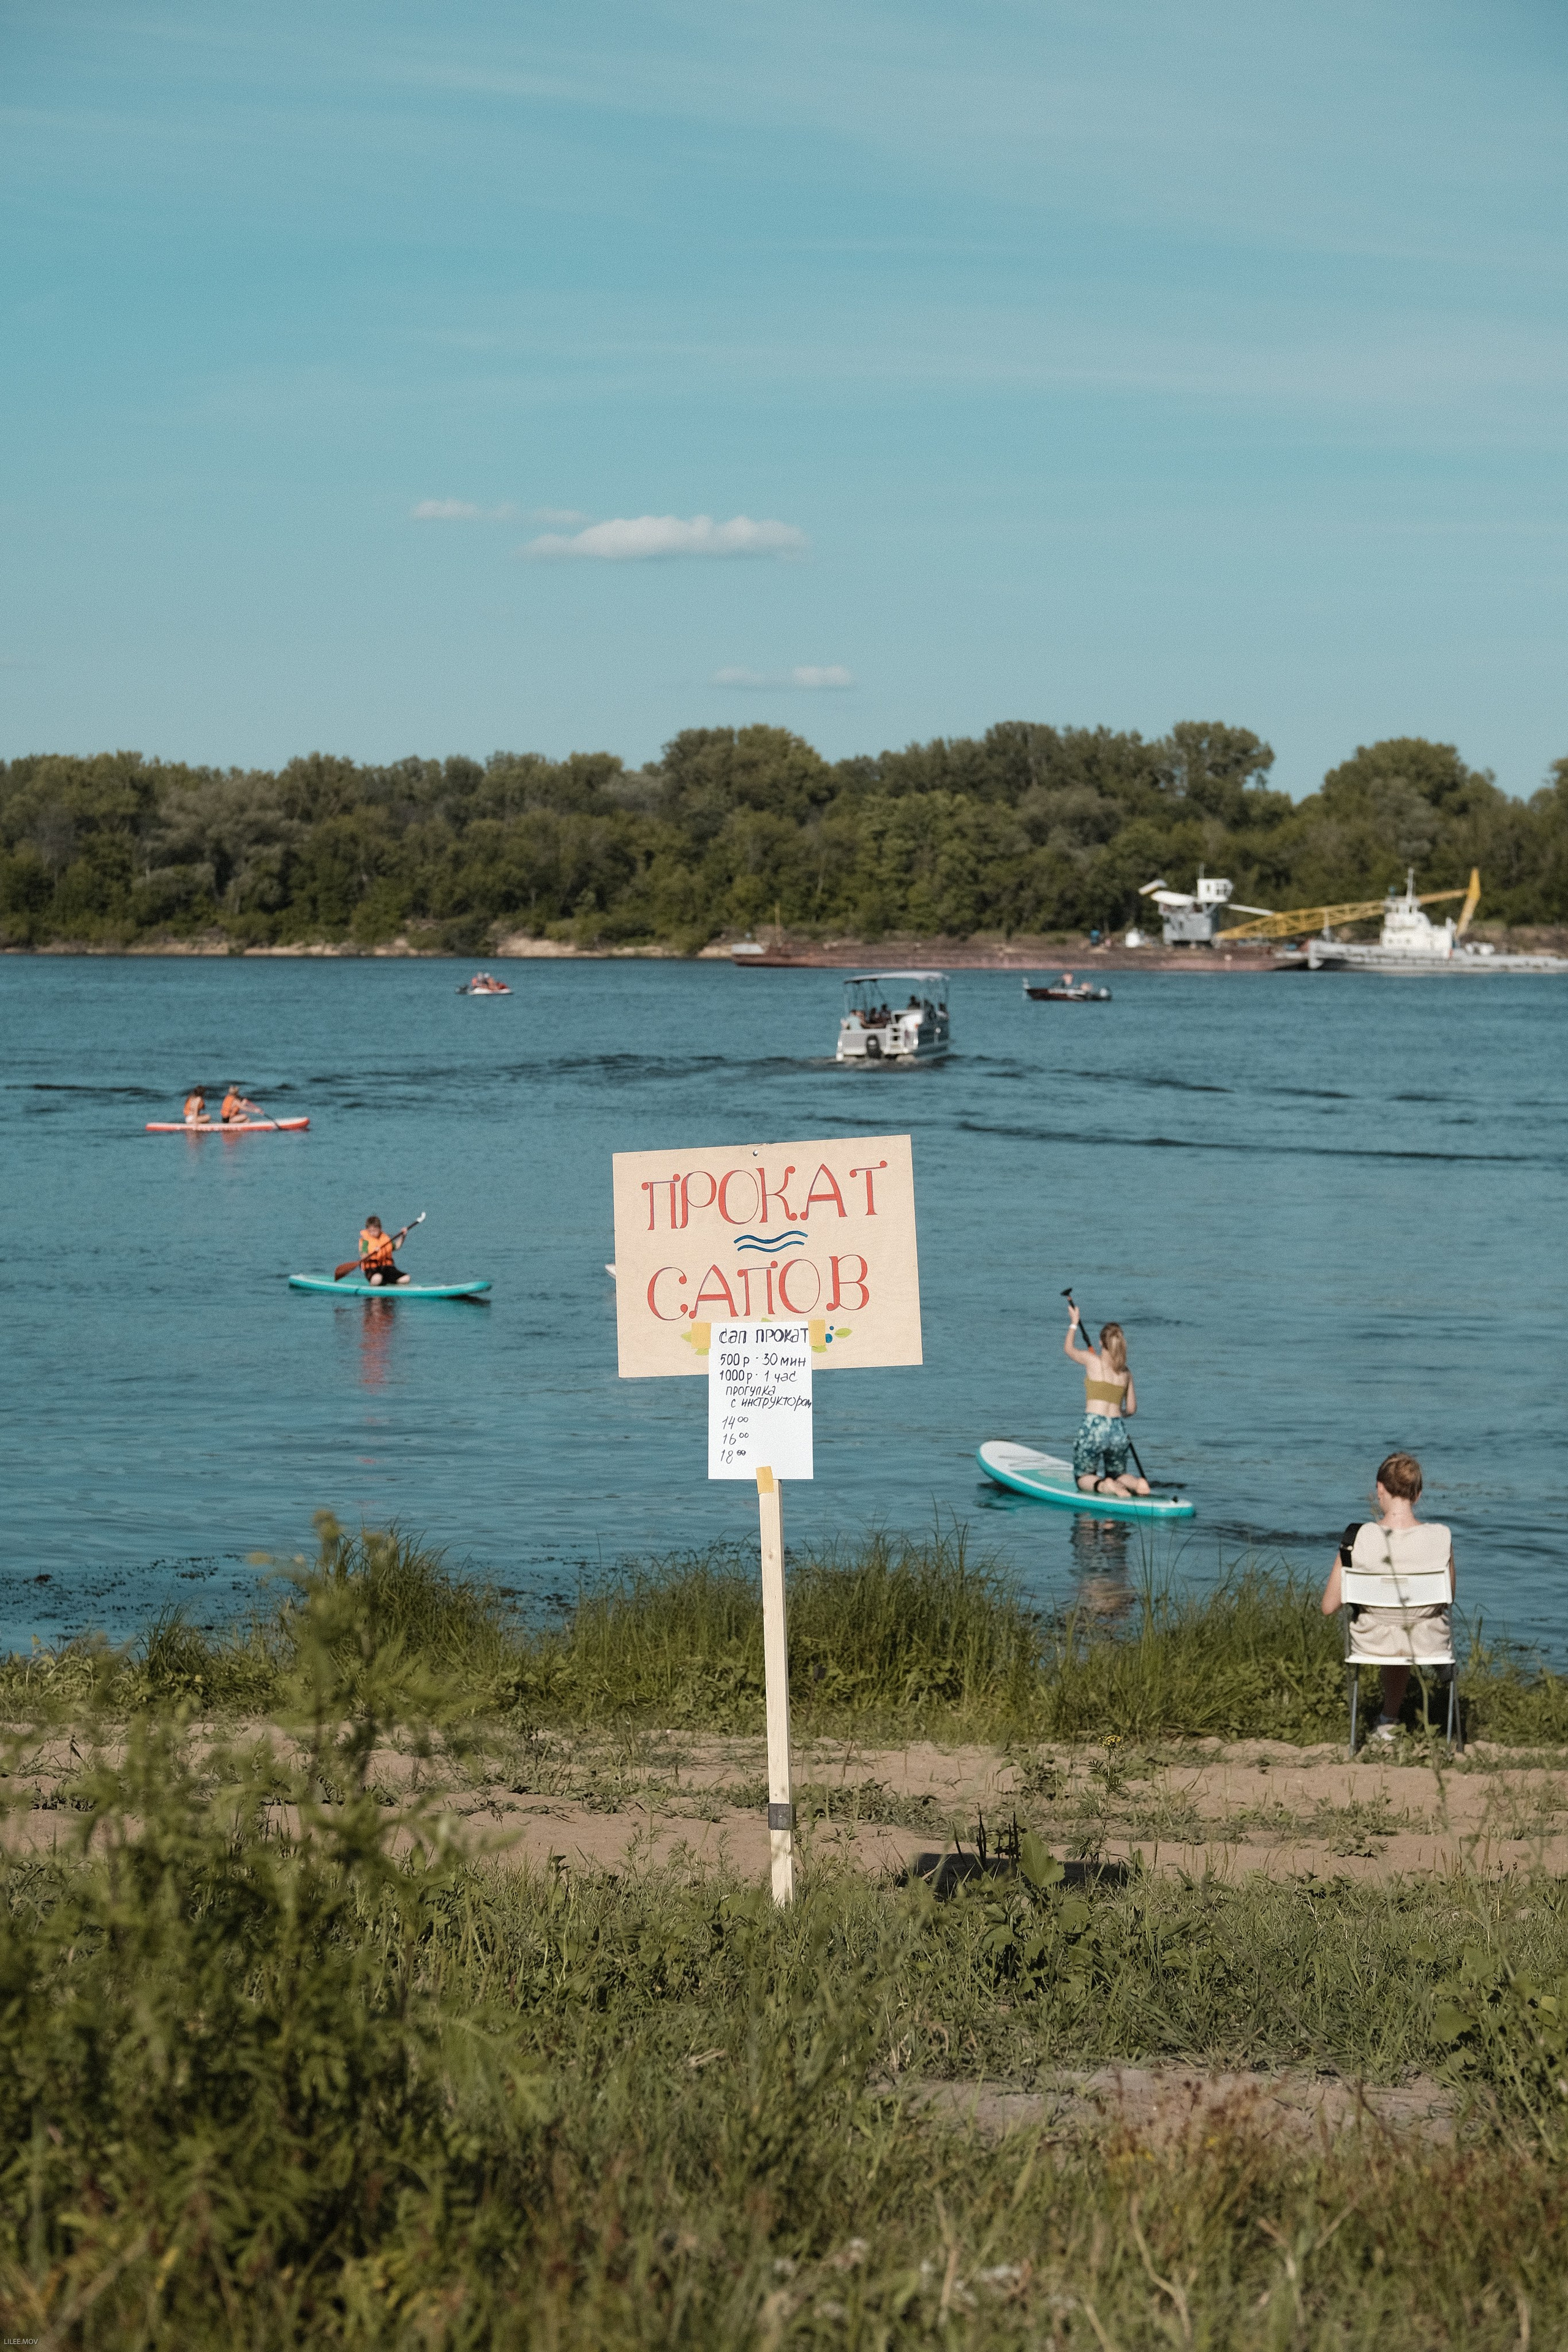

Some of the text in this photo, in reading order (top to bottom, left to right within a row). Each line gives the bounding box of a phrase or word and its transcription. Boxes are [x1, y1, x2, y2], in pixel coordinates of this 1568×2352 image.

[641, 1160, 888, 1231] ПРОКАТ
[647, 1254, 869, 1321] САПОВ
[763, 1353, 778, 1366] 30
[764, 1370, 769, 1381] 1
[775, 1371, 797, 1382] час
[726, 1386, 775, 1396] прогулка
[741, 1396, 812, 1411] инструктором
